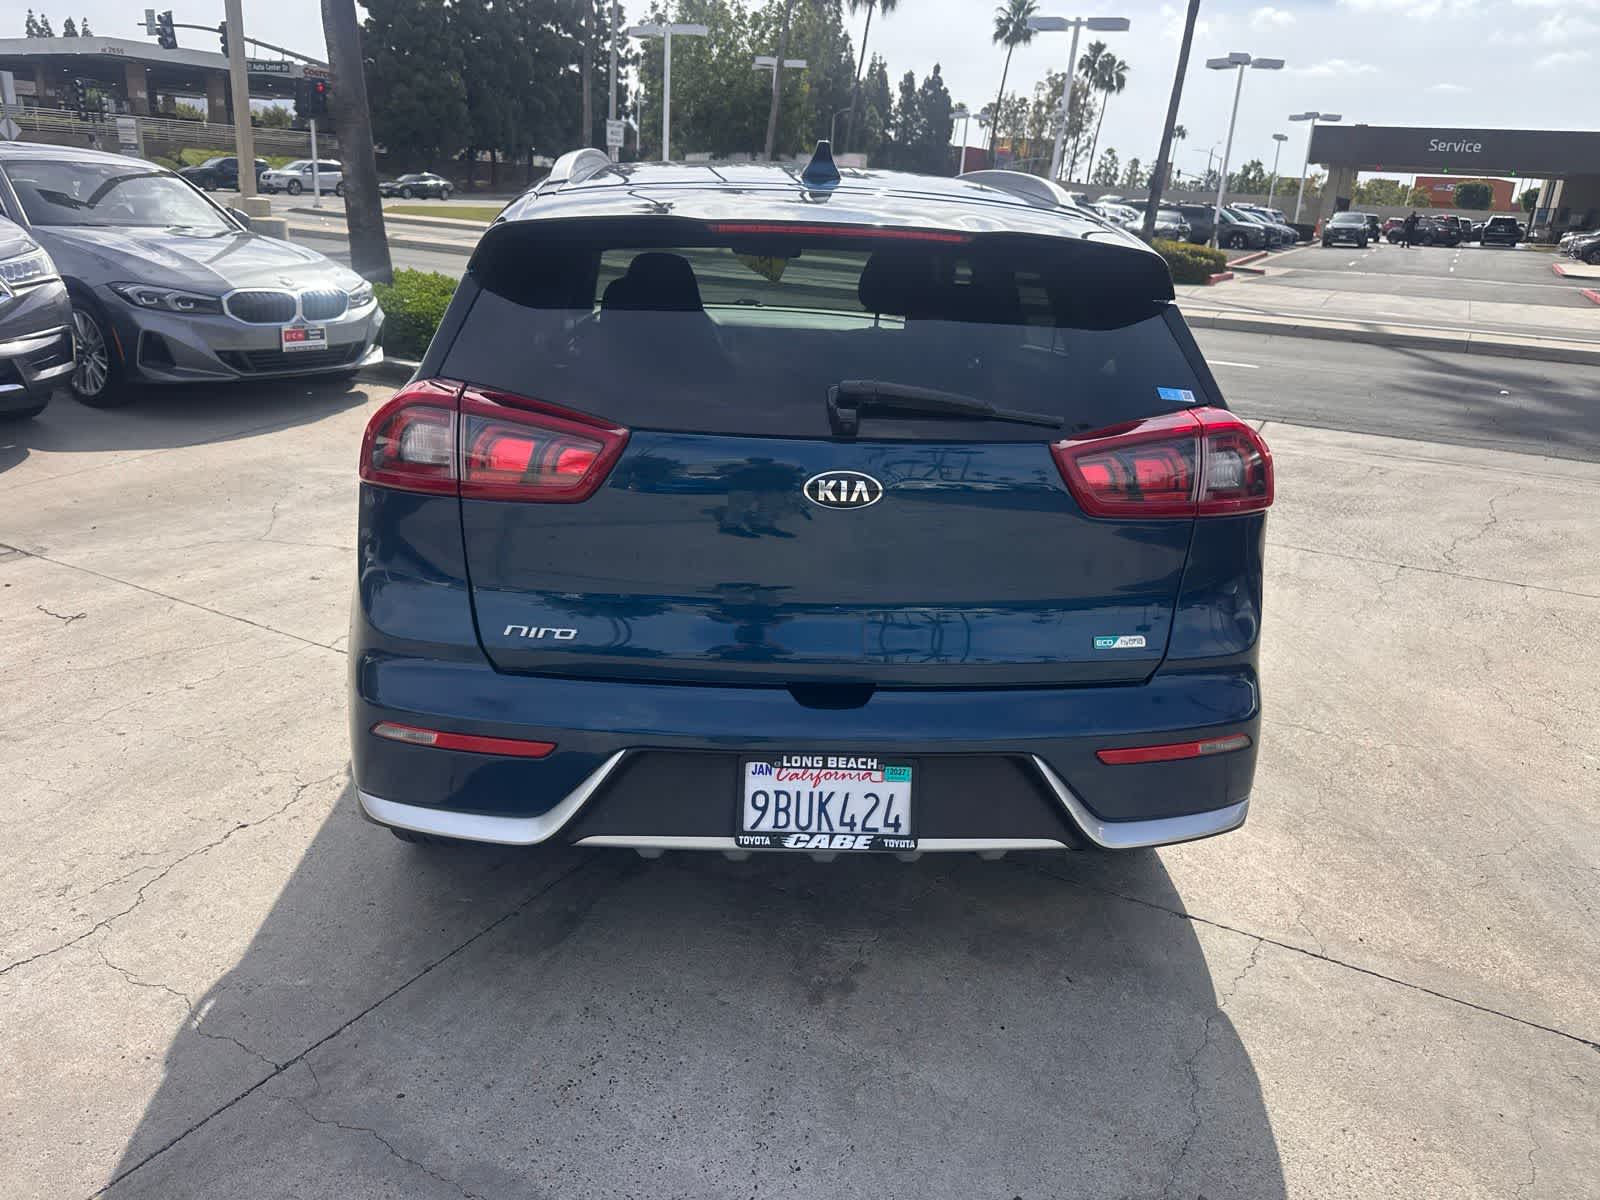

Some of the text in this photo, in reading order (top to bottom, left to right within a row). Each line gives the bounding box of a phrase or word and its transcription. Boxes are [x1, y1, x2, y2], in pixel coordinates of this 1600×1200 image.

[265, 63, 281, 72] Center
[1429, 139, 1482, 153] Service
[817, 479, 870, 502] KIA
[751, 764, 773, 776] JAN
[783, 756, 878, 769] LONG BEACH
[776, 767, 884, 788] California
[750, 789, 902, 833] 9BUK424
[738, 833, 916, 850] TOYOTA CABE TOYOTA
